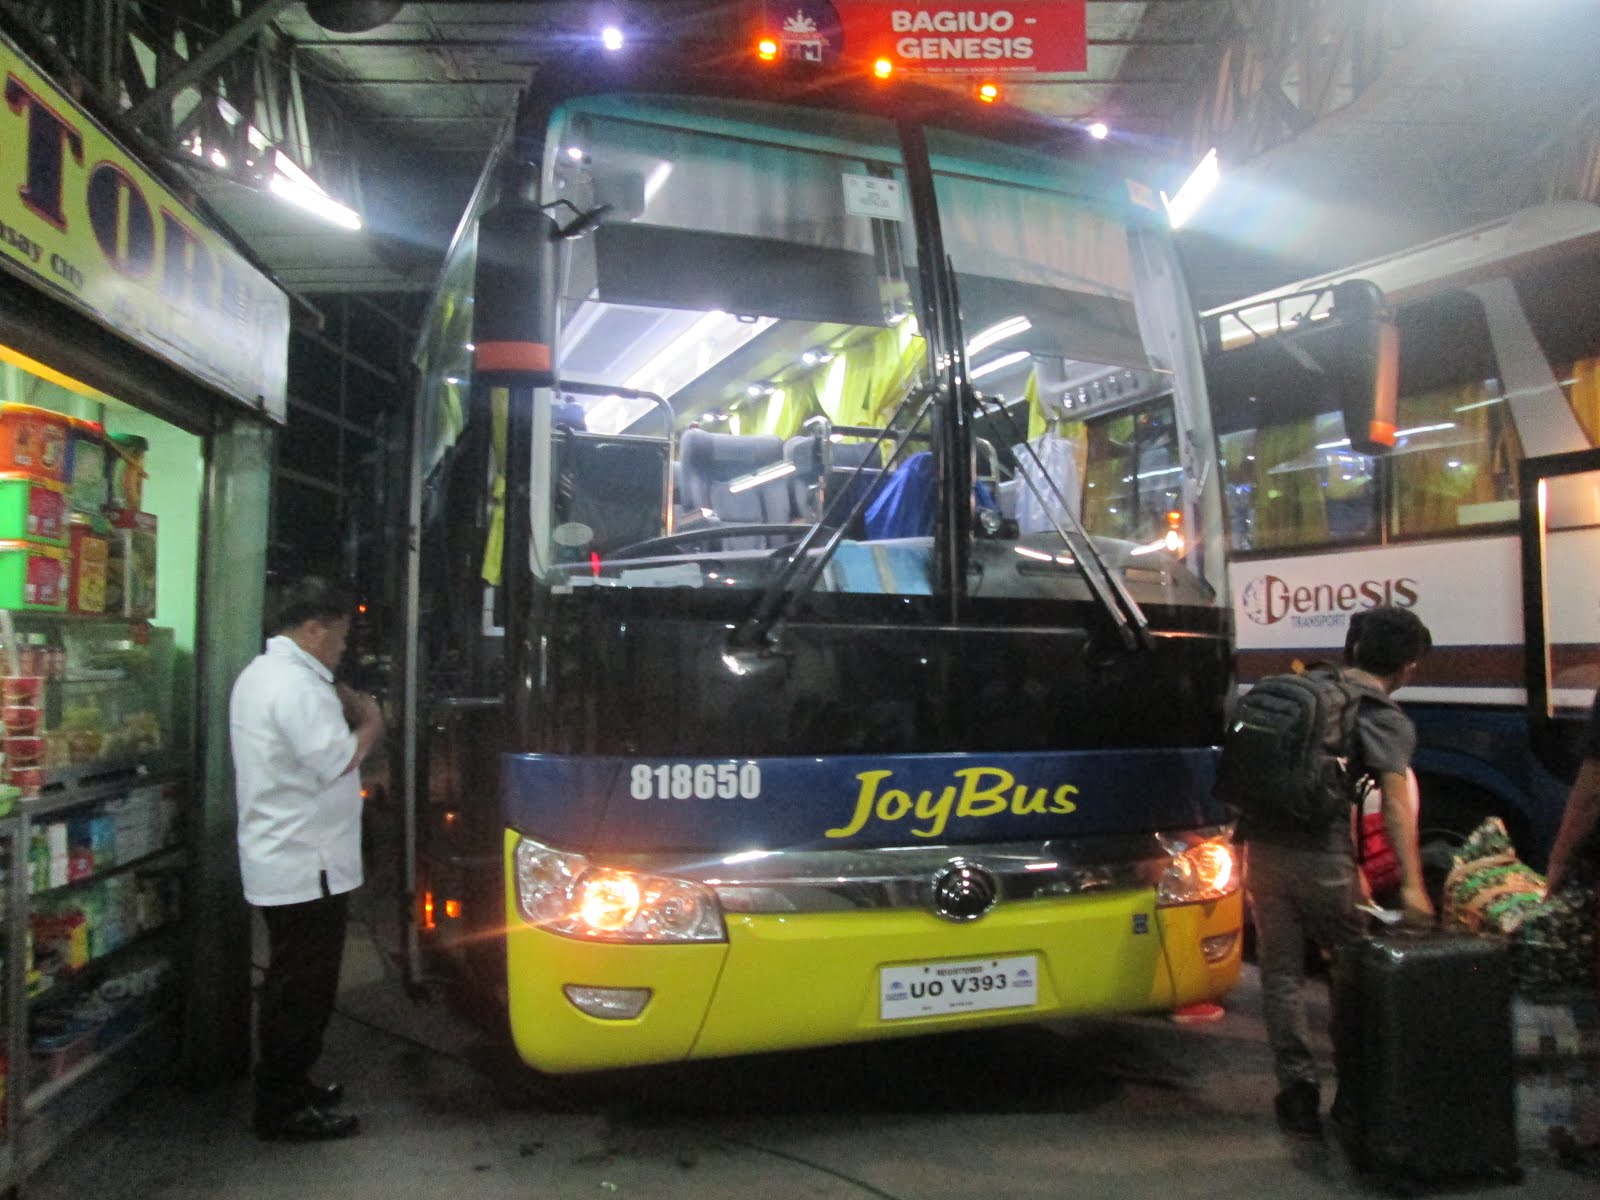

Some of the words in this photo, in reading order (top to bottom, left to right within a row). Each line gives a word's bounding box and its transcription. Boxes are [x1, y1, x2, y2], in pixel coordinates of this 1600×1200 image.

[891, 10, 1014, 32] BAGIUO
[896, 37, 1034, 60] GENESIS
[1243, 575, 1418, 625] Genesis
[630, 764, 761, 800] 818650
[824, 767, 1079, 839] JoyBus
[910, 980, 944, 999] UO
[951, 973, 1007, 995] V393
